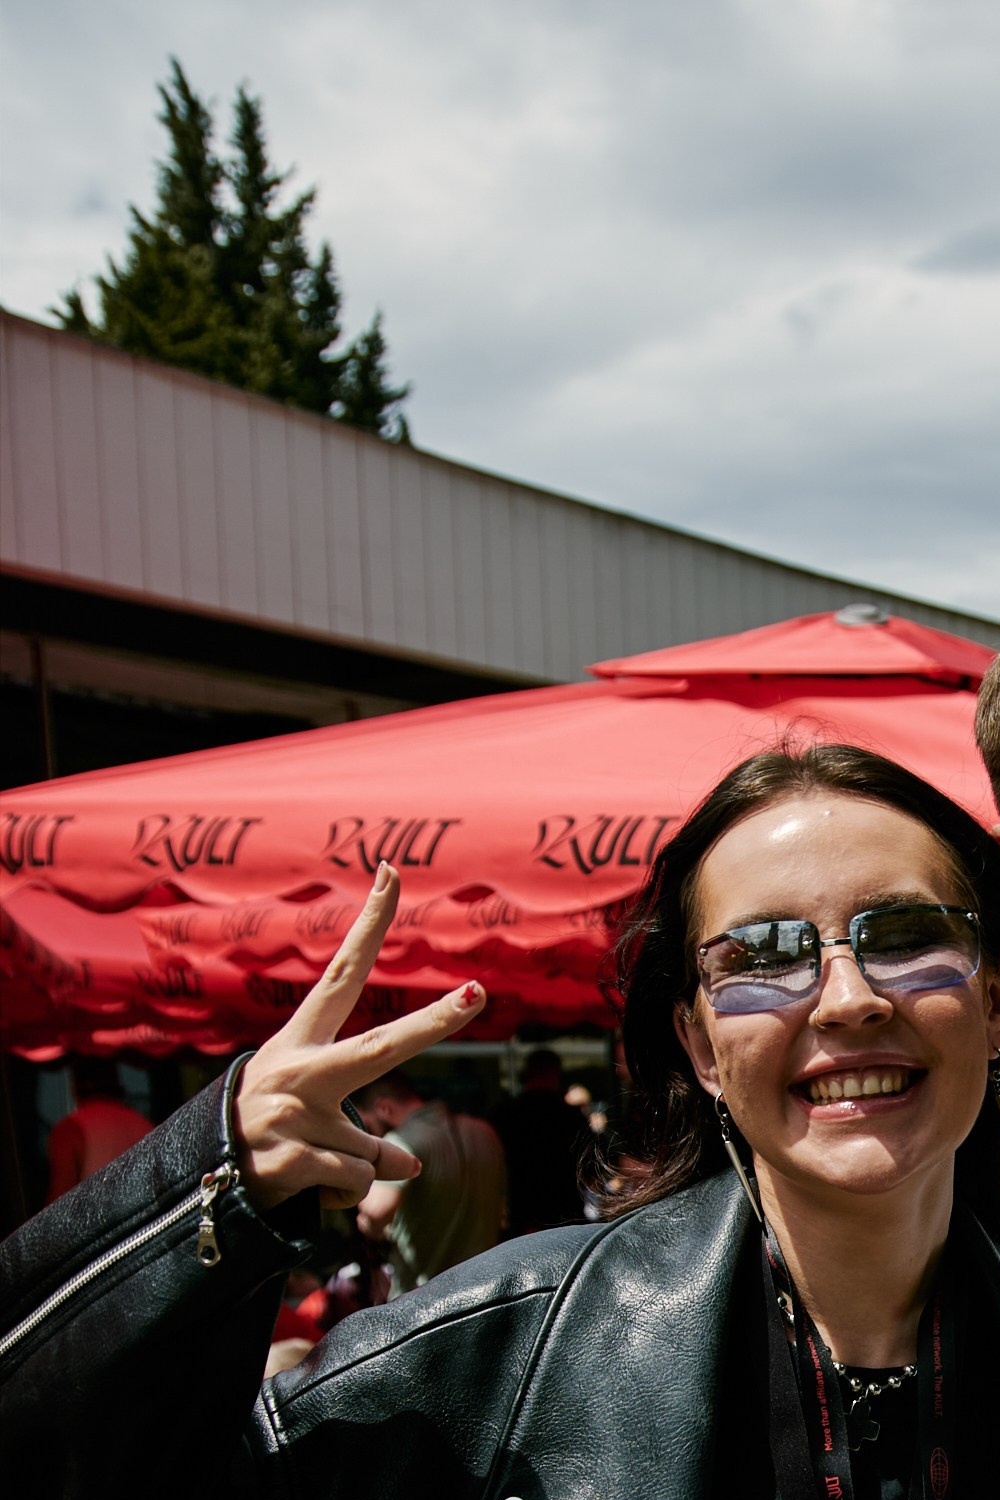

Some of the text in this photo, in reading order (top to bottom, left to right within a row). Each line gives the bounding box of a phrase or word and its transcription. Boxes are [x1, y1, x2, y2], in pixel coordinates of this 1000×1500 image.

[815, 1371, 828, 1404] affiliate
[819, 1405, 831, 1427] than
[822, 1428, 834, 1451] More
